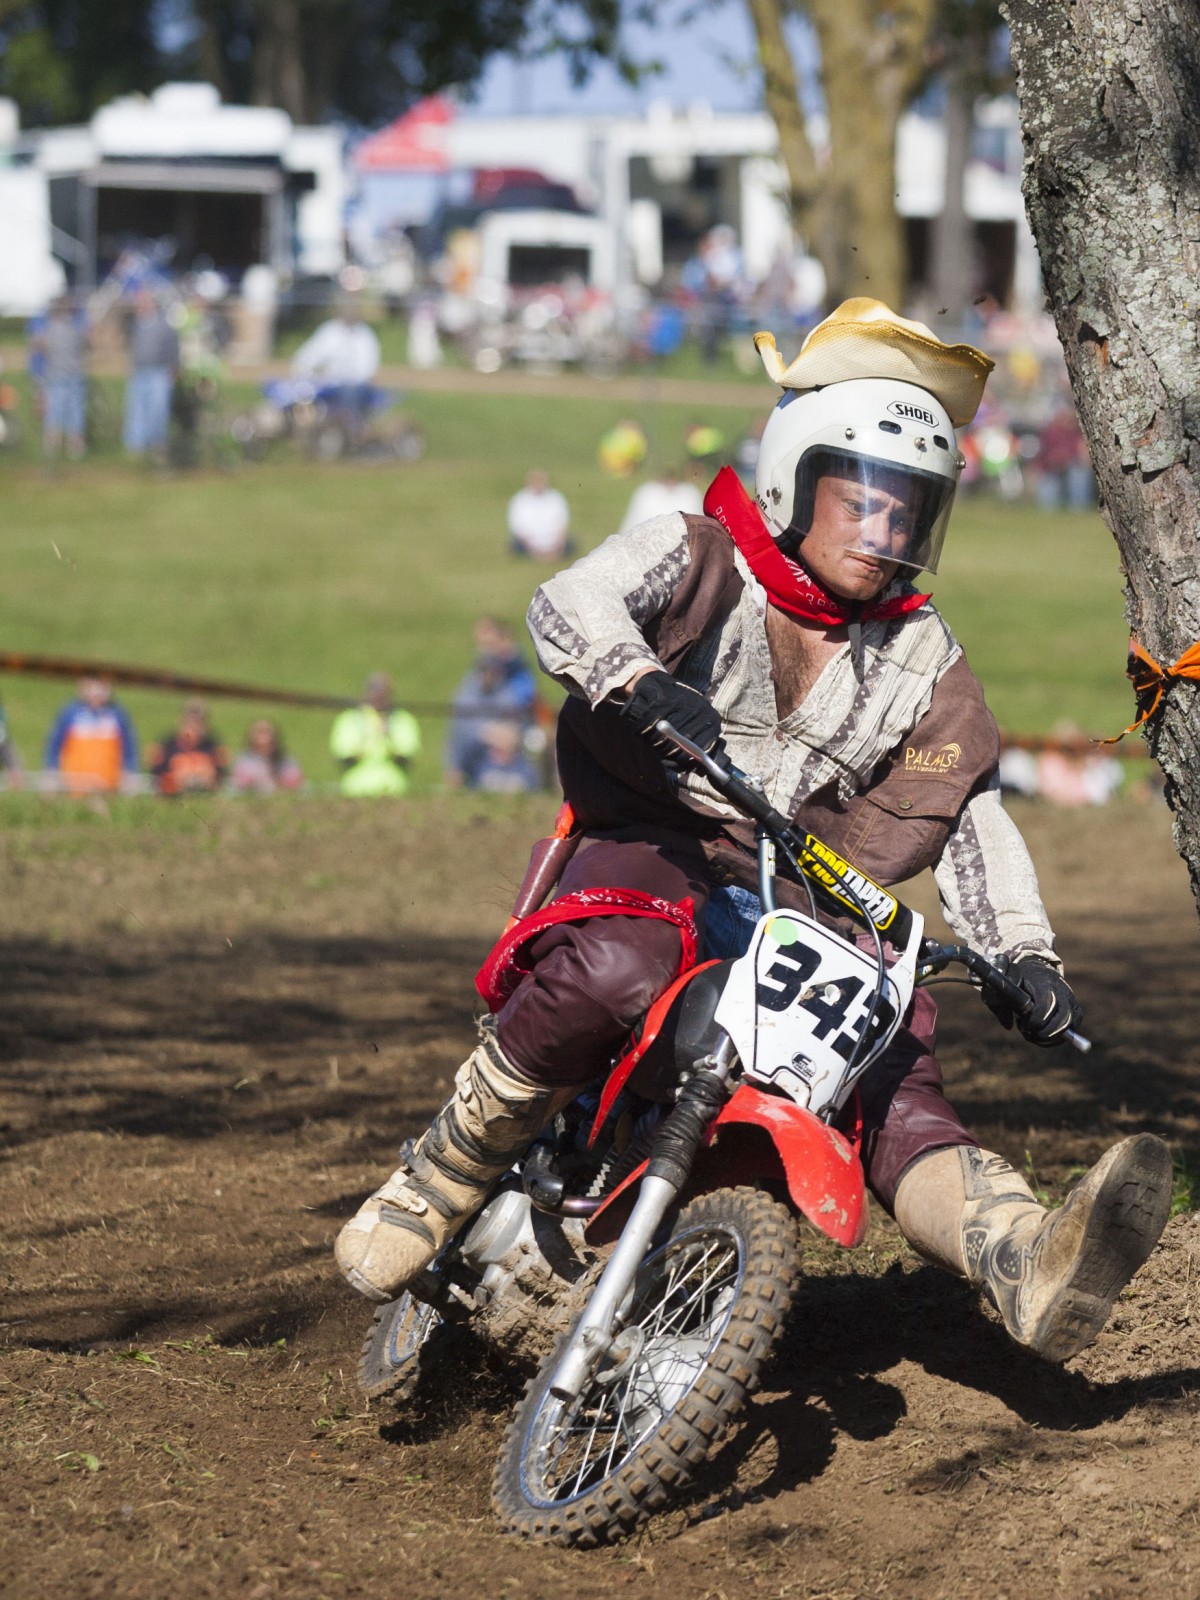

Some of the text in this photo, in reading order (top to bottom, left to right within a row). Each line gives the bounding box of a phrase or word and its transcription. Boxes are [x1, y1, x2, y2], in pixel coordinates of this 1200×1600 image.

[895, 403, 934, 425] SHOEI
[905, 747, 954, 767] PALMS
[756, 940, 897, 1069] 343
